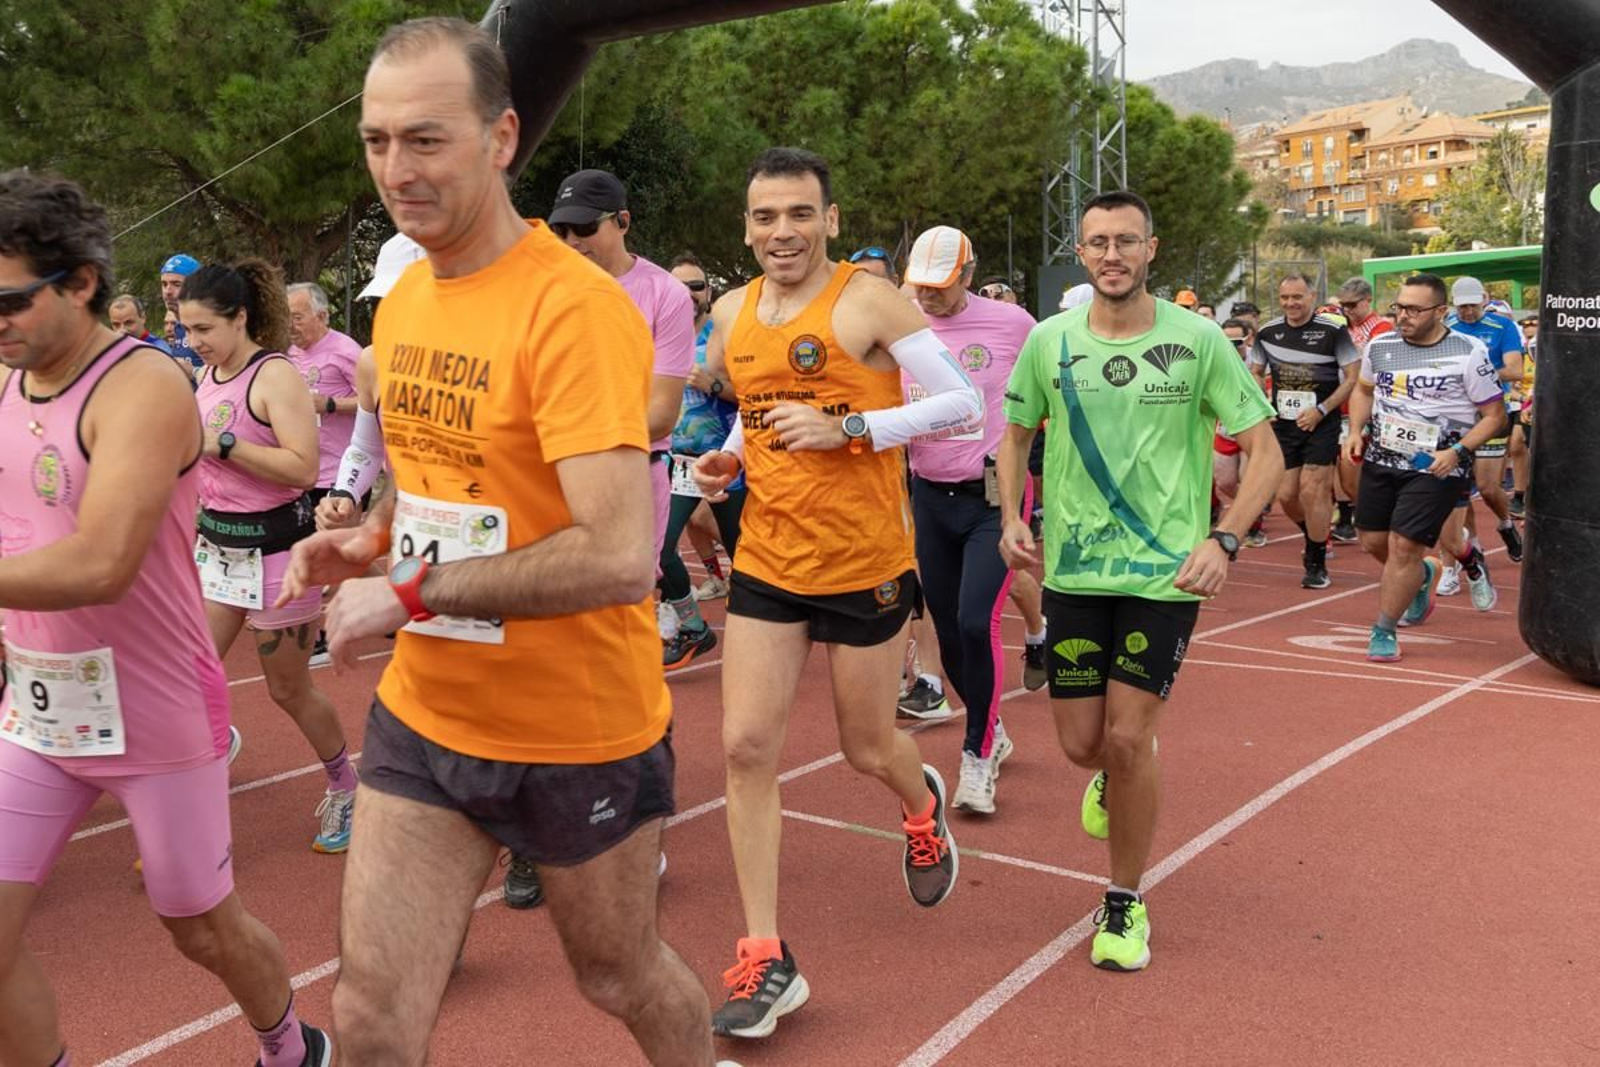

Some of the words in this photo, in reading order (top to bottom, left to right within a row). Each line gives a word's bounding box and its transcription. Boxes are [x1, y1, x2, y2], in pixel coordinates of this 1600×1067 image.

[1546, 293, 1600, 309] Patronat
[427, 349, 490, 393] MEDIA
[1144, 381, 1189, 395] Unicaja
[1286, 398, 1301, 408] 46
[1396, 427, 1417, 441] 26
[216, 522, 266, 536] ESPAÑOLA
[218, 560, 229, 577] 7
[1057, 667, 1100, 682] Unicaja
[30, 680, 49, 712] 9
